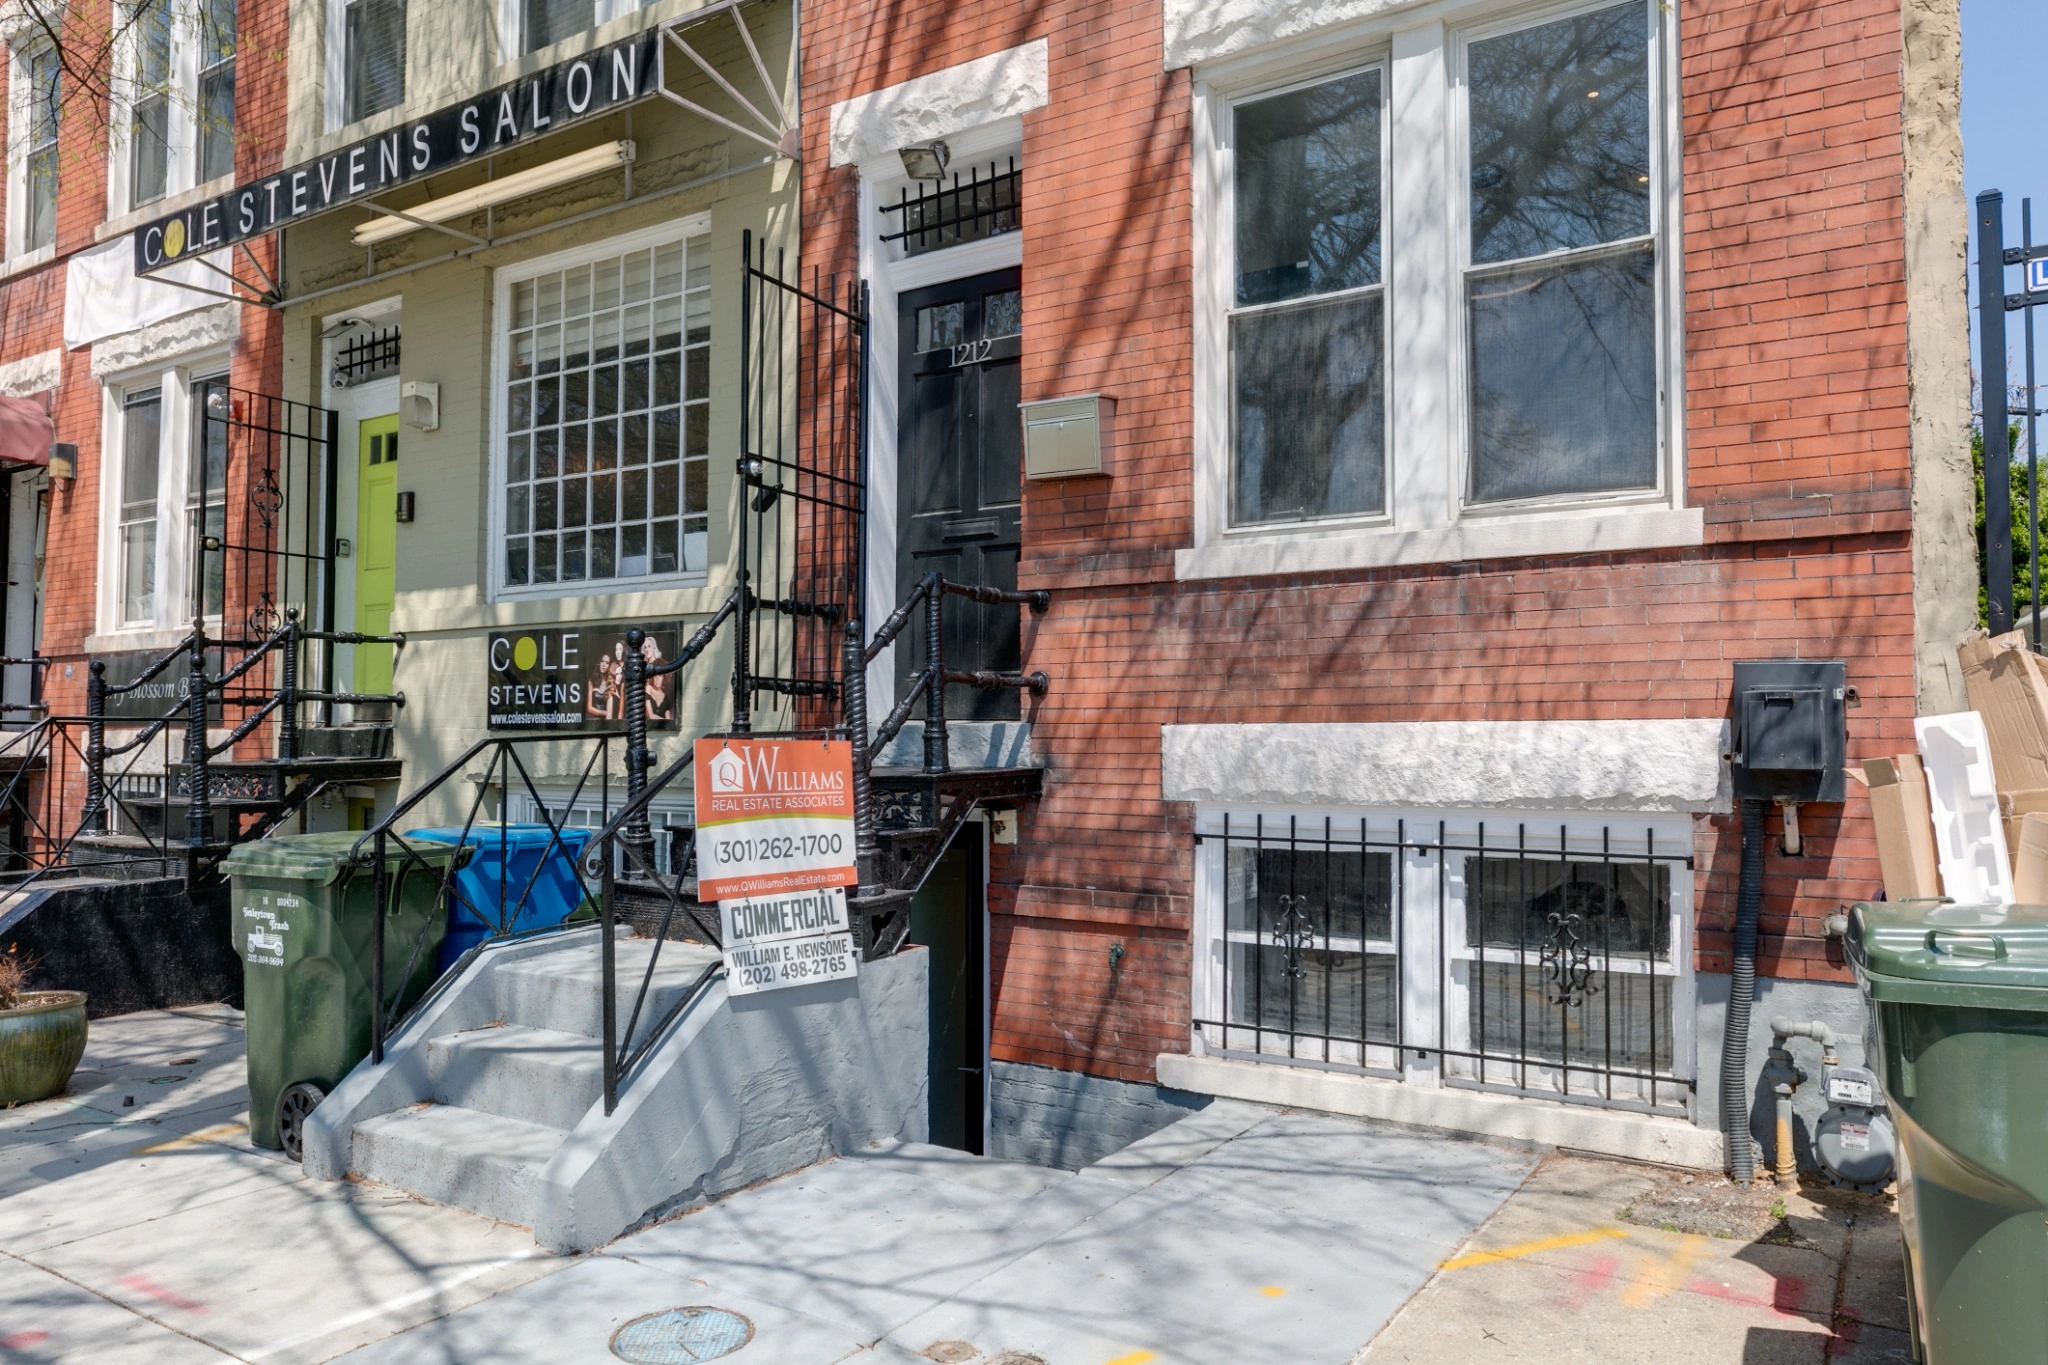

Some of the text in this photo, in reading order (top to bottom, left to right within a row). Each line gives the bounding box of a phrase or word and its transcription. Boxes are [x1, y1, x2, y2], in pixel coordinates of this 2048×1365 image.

[144, 44, 635, 266] COLE STEVENS SALON
[948, 339, 992, 368] 1212
[490, 633, 580, 672] COLE
[490, 682, 581, 706] STEVENS
[490, 711, 582, 725] www.colestevenssalon.com
[712, 795, 845, 811] REAL ESTATE ASSOCIATES
[714, 833, 842, 865] (301)262-1700
[716, 872, 845, 894] www.QWilliamsRealEstate.com
[731, 895, 840, 940] COMMERCIAL
[732, 938, 848, 968] WILLIAM E. NEWSOME
[739, 955, 847, 987] (202) 498-2765
